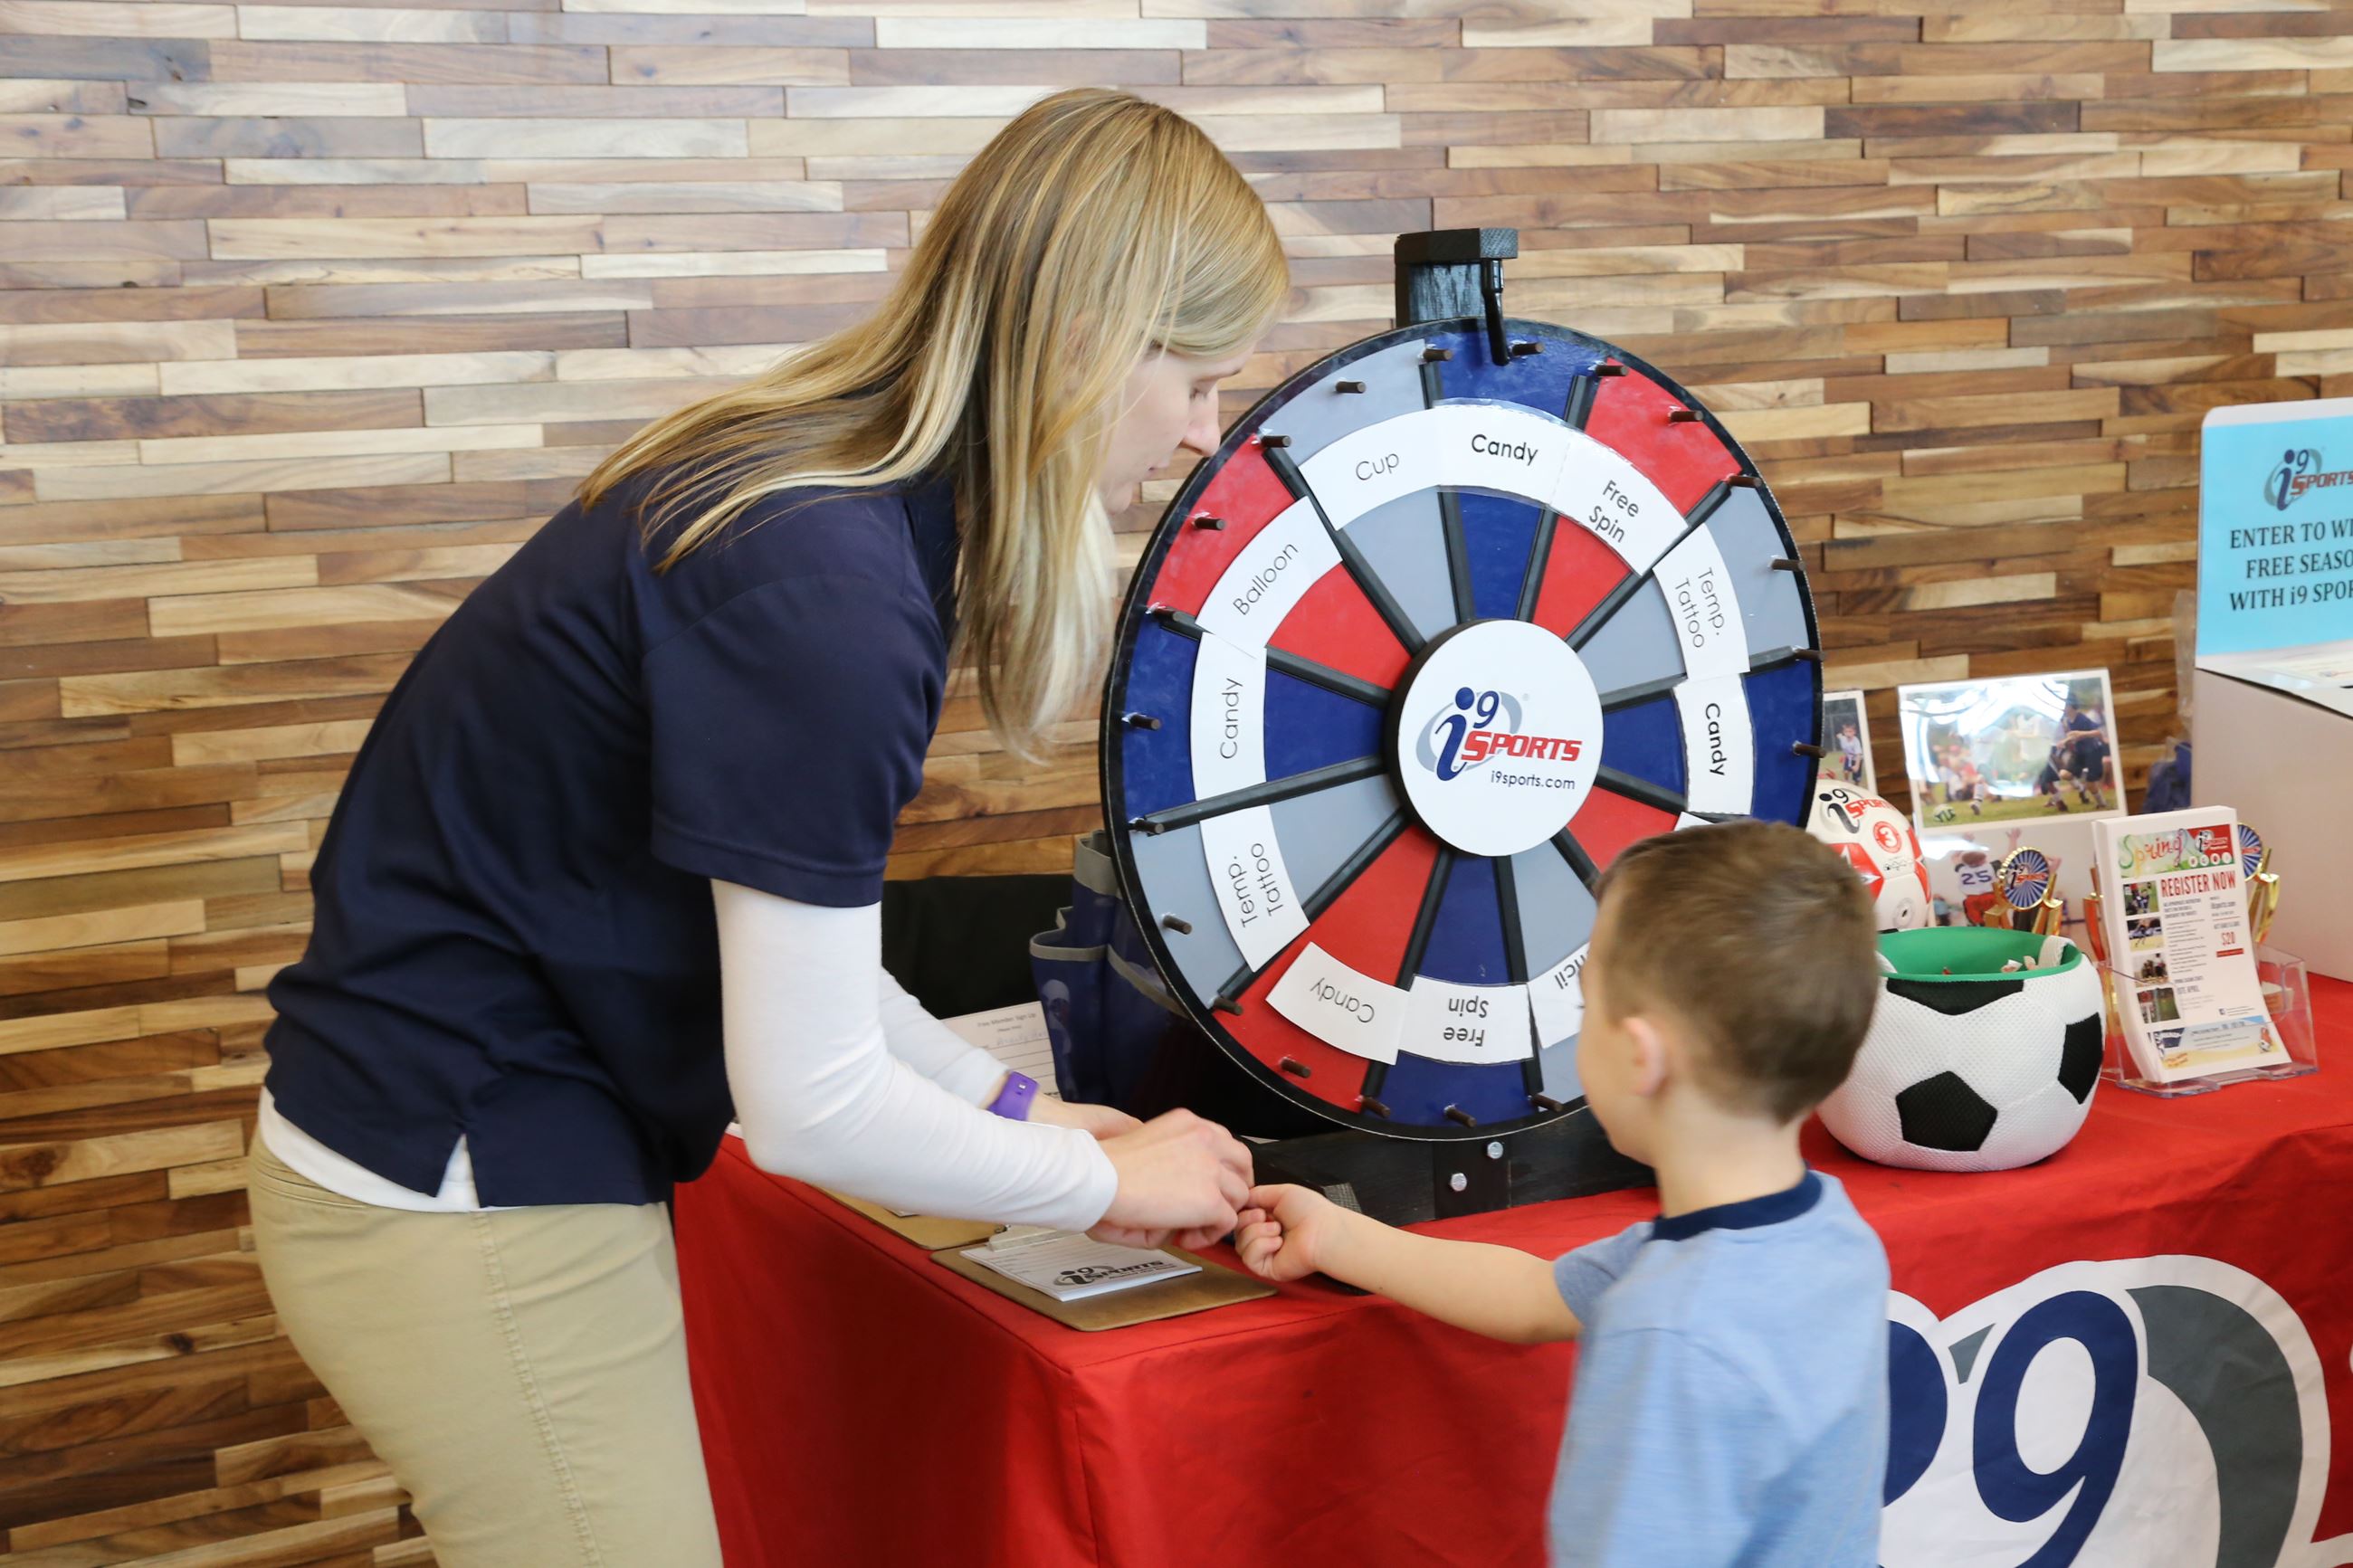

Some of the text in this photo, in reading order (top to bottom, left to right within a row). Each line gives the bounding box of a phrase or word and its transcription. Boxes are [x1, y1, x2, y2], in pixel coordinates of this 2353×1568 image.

[1355, 452, 1400, 481] Cup
[1471, 433, 1538, 466] Candy
[2274, 449, 2310, 511] i9
[1602, 480, 1640, 518] Free
[1588, 505, 1625, 543] Spin
[2230, 518, 2353, 549] ENTER TO WI
[1232, 543, 1300, 615] Balloon
[2246, 548, 2353, 579] FREE SEASO
[1674, 577, 1705, 648] Tattoo
[1697, 566, 1725, 636] Temp.
[2229, 587, 2285, 612] WITH
[2290, 584, 2308, 605] i9
[1220, 677, 1243, 759] Candy
[1434, 686, 1500, 782] i9
[1461, 730, 1583, 762] SPORTS
[1705, 702, 1728, 776] Candy
[1491, 770, 1576, 790] i9sports.com
[1879, 826, 1898, 849] 3
[2119, 827, 2188, 879] Spring
[1227, 855, 1259, 928] Temp.
[1251, 842, 1284, 917] Tattoo
[1961, 870, 1992, 886] 25
[2159, 870, 2236, 898] REGISTER NOW
[2221, 931, 2236, 946] $20
[1554, 955, 1586, 991] ncil
[1310, 976, 1376, 1023] Candy
[1448, 994, 1490, 1019] Spin
[1443, 1027, 1485, 1047] Free
